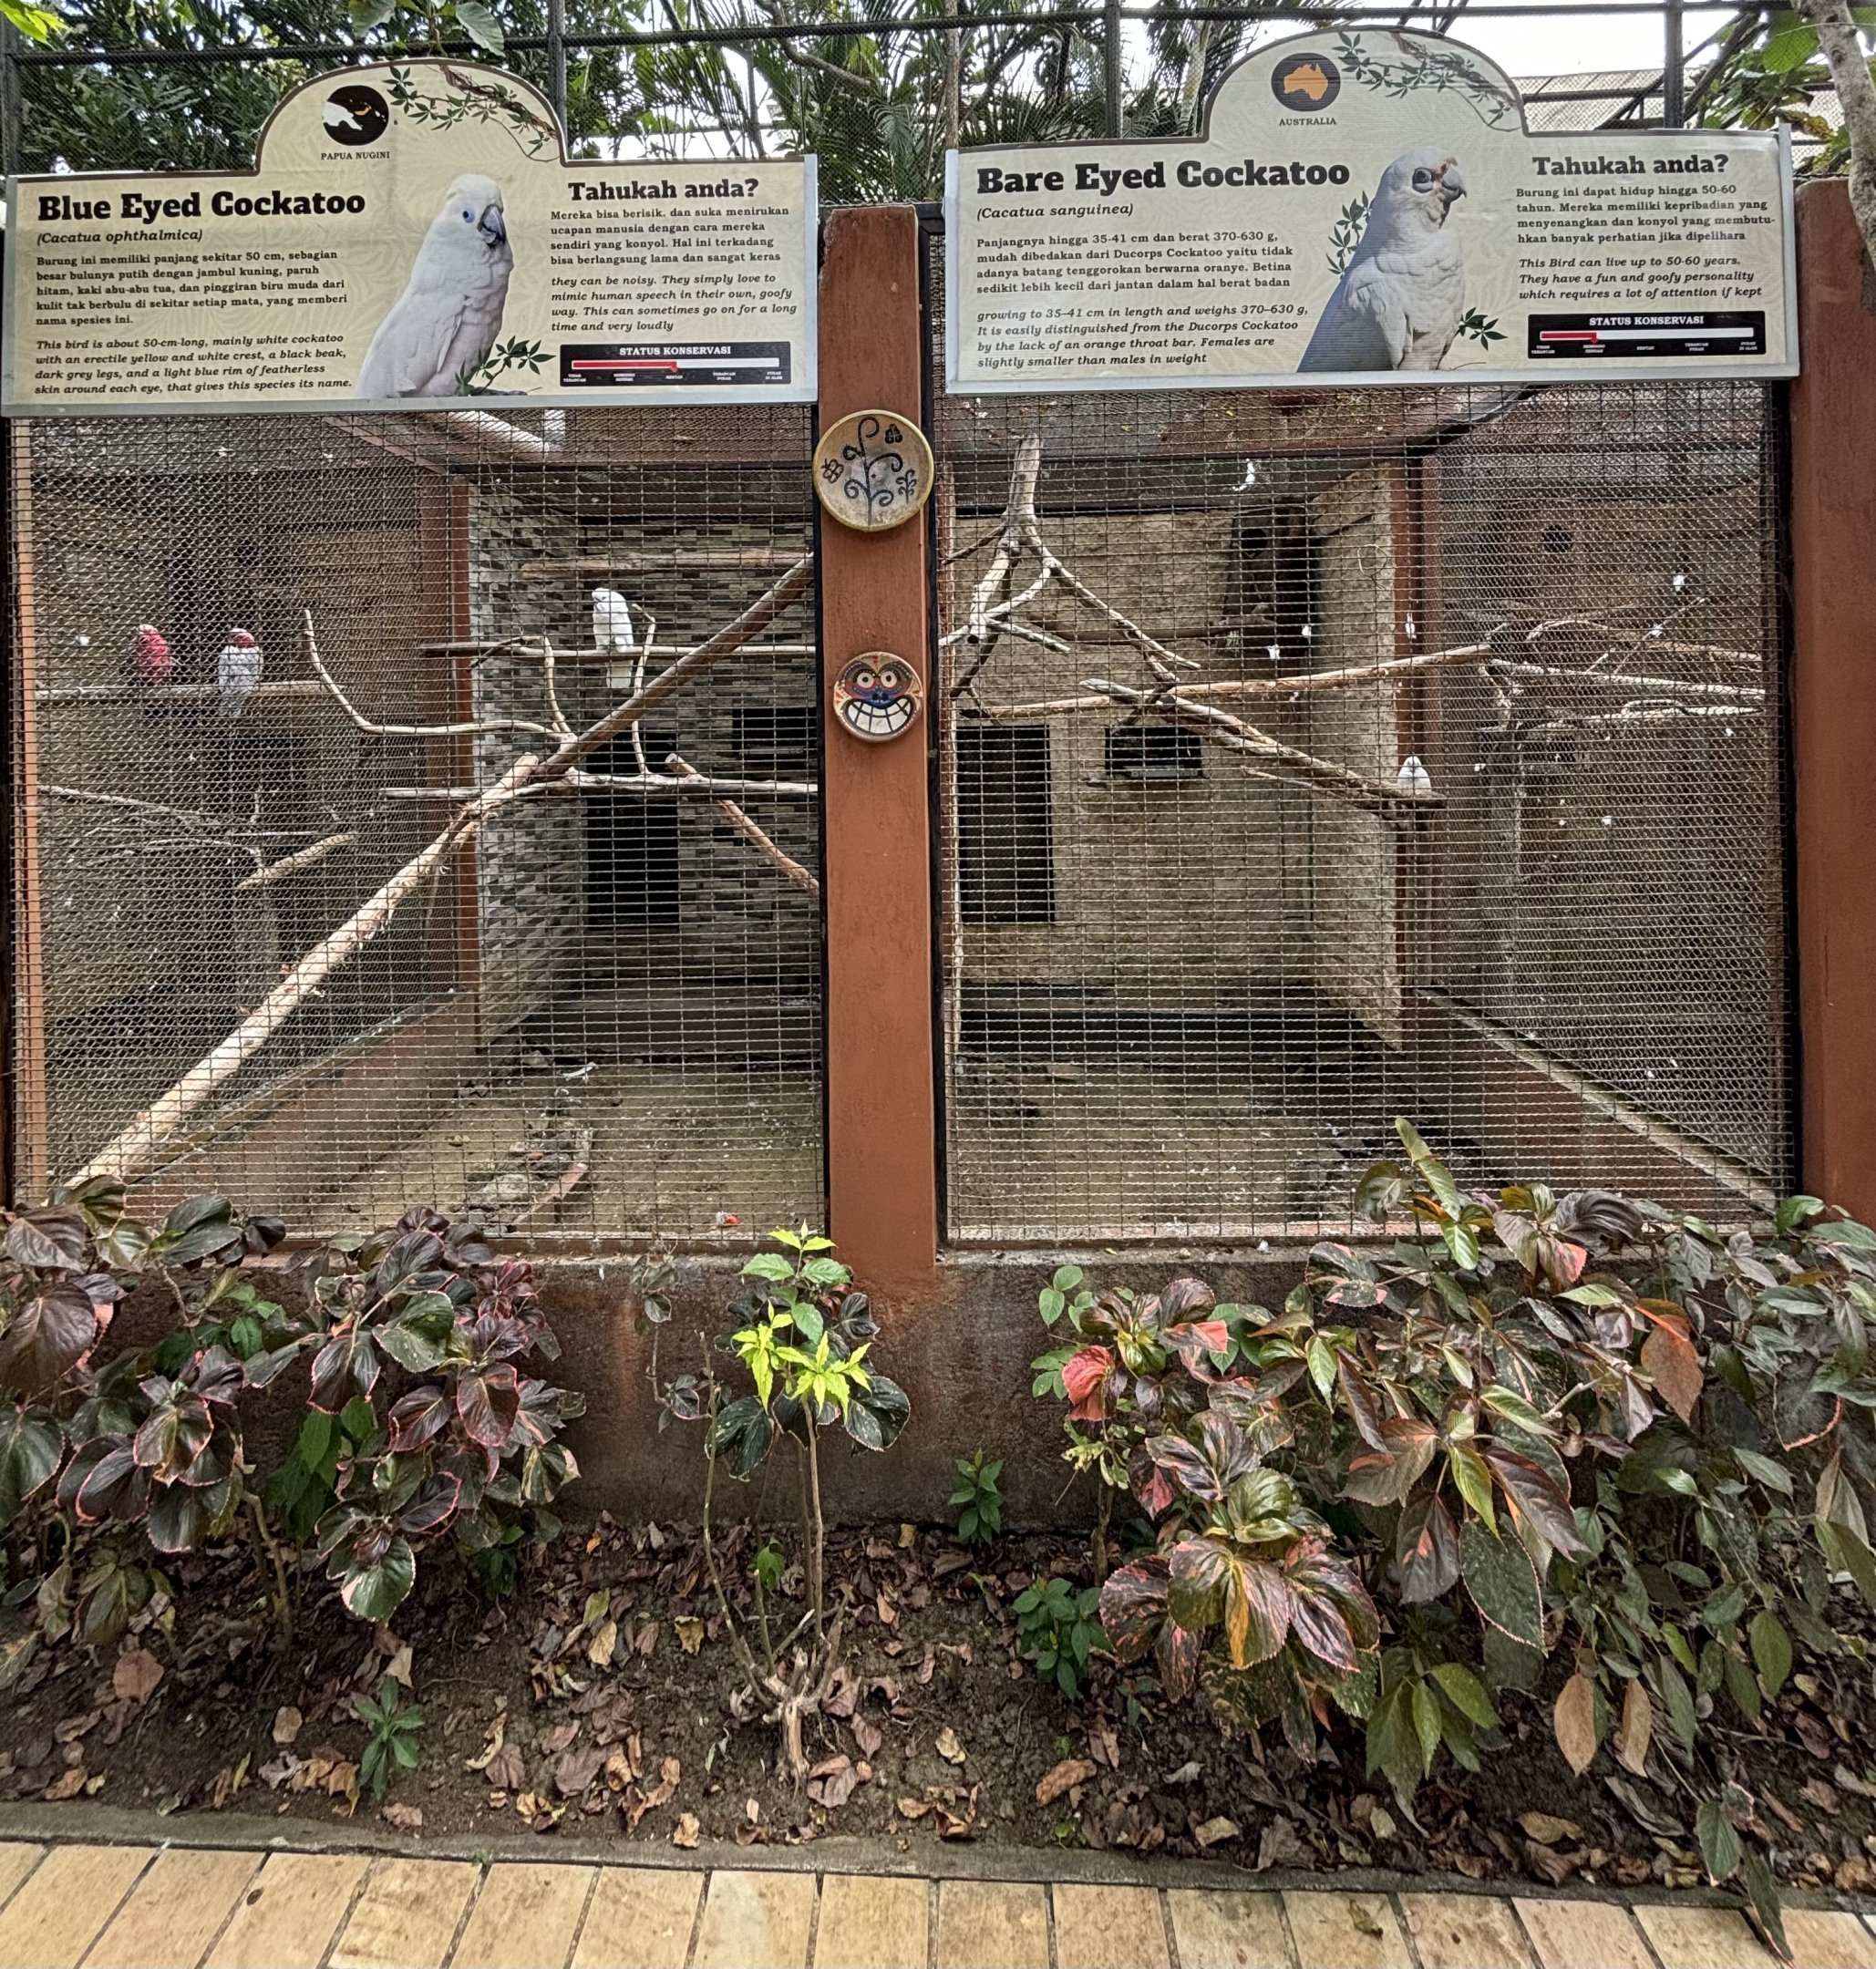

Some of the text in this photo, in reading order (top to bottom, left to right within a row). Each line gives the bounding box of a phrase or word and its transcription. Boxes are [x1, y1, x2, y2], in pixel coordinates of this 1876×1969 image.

[1278, 117, 1336, 126] AUSTRALIA
[321, 150, 389, 160] PAPUA NUGINI
[1532, 153, 1728, 175] Tahukah anda?
[976, 159, 1349, 196] Bare Eyed Cockatoo
[568, 178, 758, 201] Tahukah anda?
[1516, 184, 1736, 199] Burung ini dapat hidup hingga 50-60
[37, 190, 365, 224] Blue Eyed Cockatoo
[551, 206, 789, 220] Mereka bisa berisik. dan suka menirukan
[976, 202, 1133, 222] (Cacatua sanguinea)
[1516, 200, 1768, 212] tahun. Mereka memiliki kepribadian yang
[1517, 214, 1775, 230] menyenangkan dan konyol yang membutu-
[36, 229, 202, 246] (Cacatua ophthalmica)
[976, 237, 1045, 249] Panjangnya
[1048, 235, 1088, 246] hingga
[1092, 233, 1126, 243] 35-41
[1152, 232, 1175, 242] dan
[1178, 232, 1210, 242] berat
[1213, 231, 1263, 241] 370-630
[1267, 232, 1277, 242] g,
[36, 250, 337, 267] Burung ini memiliki panjang sekitar 50 cm, sebagian
[36, 264, 319, 281] besar bulunya putih dengan jambul kuning, paruh
[551, 276, 577, 288] they
[605, 275, 619, 284] be
[623, 275, 656, 286] noisy.
[661, 274, 690, 285] They
[693, 273, 733, 285] simply
[737, 273, 760, 283] love
[764, 273, 776, 282] to
[1519, 273, 1549, 285] They
[1551, 273, 1581, 283] have
[1593, 273, 1616, 284] fun
[1620, 273, 1644, 282] and
[1647, 272, 1681, 283] goofy
[1683, 271, 1754, 283] personality
[976, 277, 1290, 294] sedikit lebih kecil dari jantan dalam hal berat badan
[1519, 289, 1556, 299] which
[1560, 289, 1609, 301] requires
[1625, 288, 1642, 297] lot
[1645, 287, 1659, 300] of
[1661, 287, 1717, 297] attention
[1721, 286, 1732, 299] if
[1734, 286, 1761, 298] kept
[36, 294, 347, 310] kulit tak berbulu di sekitar setiap mata, yang memberi
[551, 287, 792, 302] mimic human speech in their own, goofy
[977, 320, 1298, 336] It is easily distinguished from the Ducorps Cockatoo
[1589, 315, 1704, 325] STATUS KONSERVASI
[36, 334, 343, 349] This bird is about 50-cm-long, mainly white cockatoo
[977, 342, 992, 354] by
[995, 341, 1015, 351] the
[1018, 340, 1045, 350] lack
[1048, 339, 1062, 352] of
[1083, 341, 1126, 351] orange
[1129, 338, 1169, 347] throat
[1171, 337, 1195, 346] bar.
[1200, 336, 1251, 346] Females
[36, 355, 62, 364] with
[83, 354, 128, 363] erectile
[129, 353, 169, 365] yellow
[170, 352, 194, 362] and
[197, 351, 230, 361] white
[232, 351, 264, 361] crest,
[279, 349, 312, 358] black
[314, 348, 345, 358] beak,
[619, 345, 731, 356] STATUS KONSERVASI
